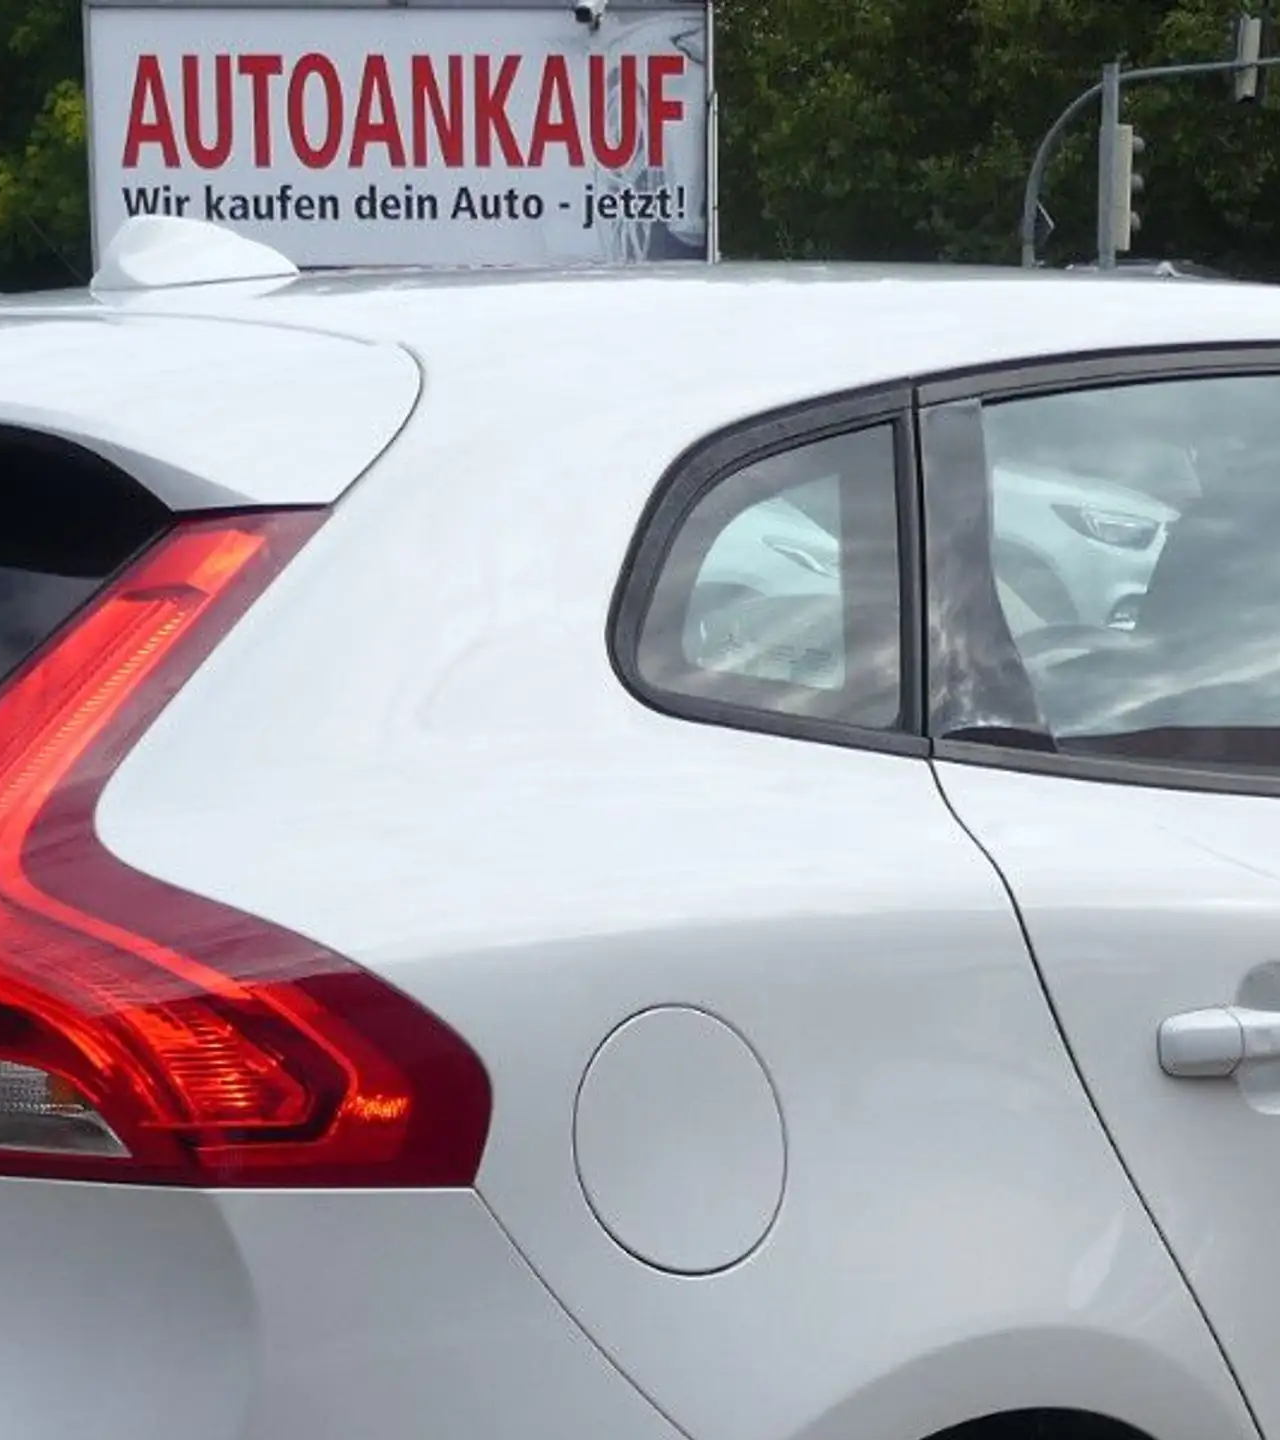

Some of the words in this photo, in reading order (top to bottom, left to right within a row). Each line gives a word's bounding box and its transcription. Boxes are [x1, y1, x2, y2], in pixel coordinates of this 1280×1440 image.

[122, 53, 684, 169] AUTOANKAUF
[123, 186, 190, 217] Wir
[204, 185, 339, 221] kaufen
[354, 185, 439, 221] dein
[451, 186, 544, 220] Auto
[583, 184, 685, 229] jetzt!
